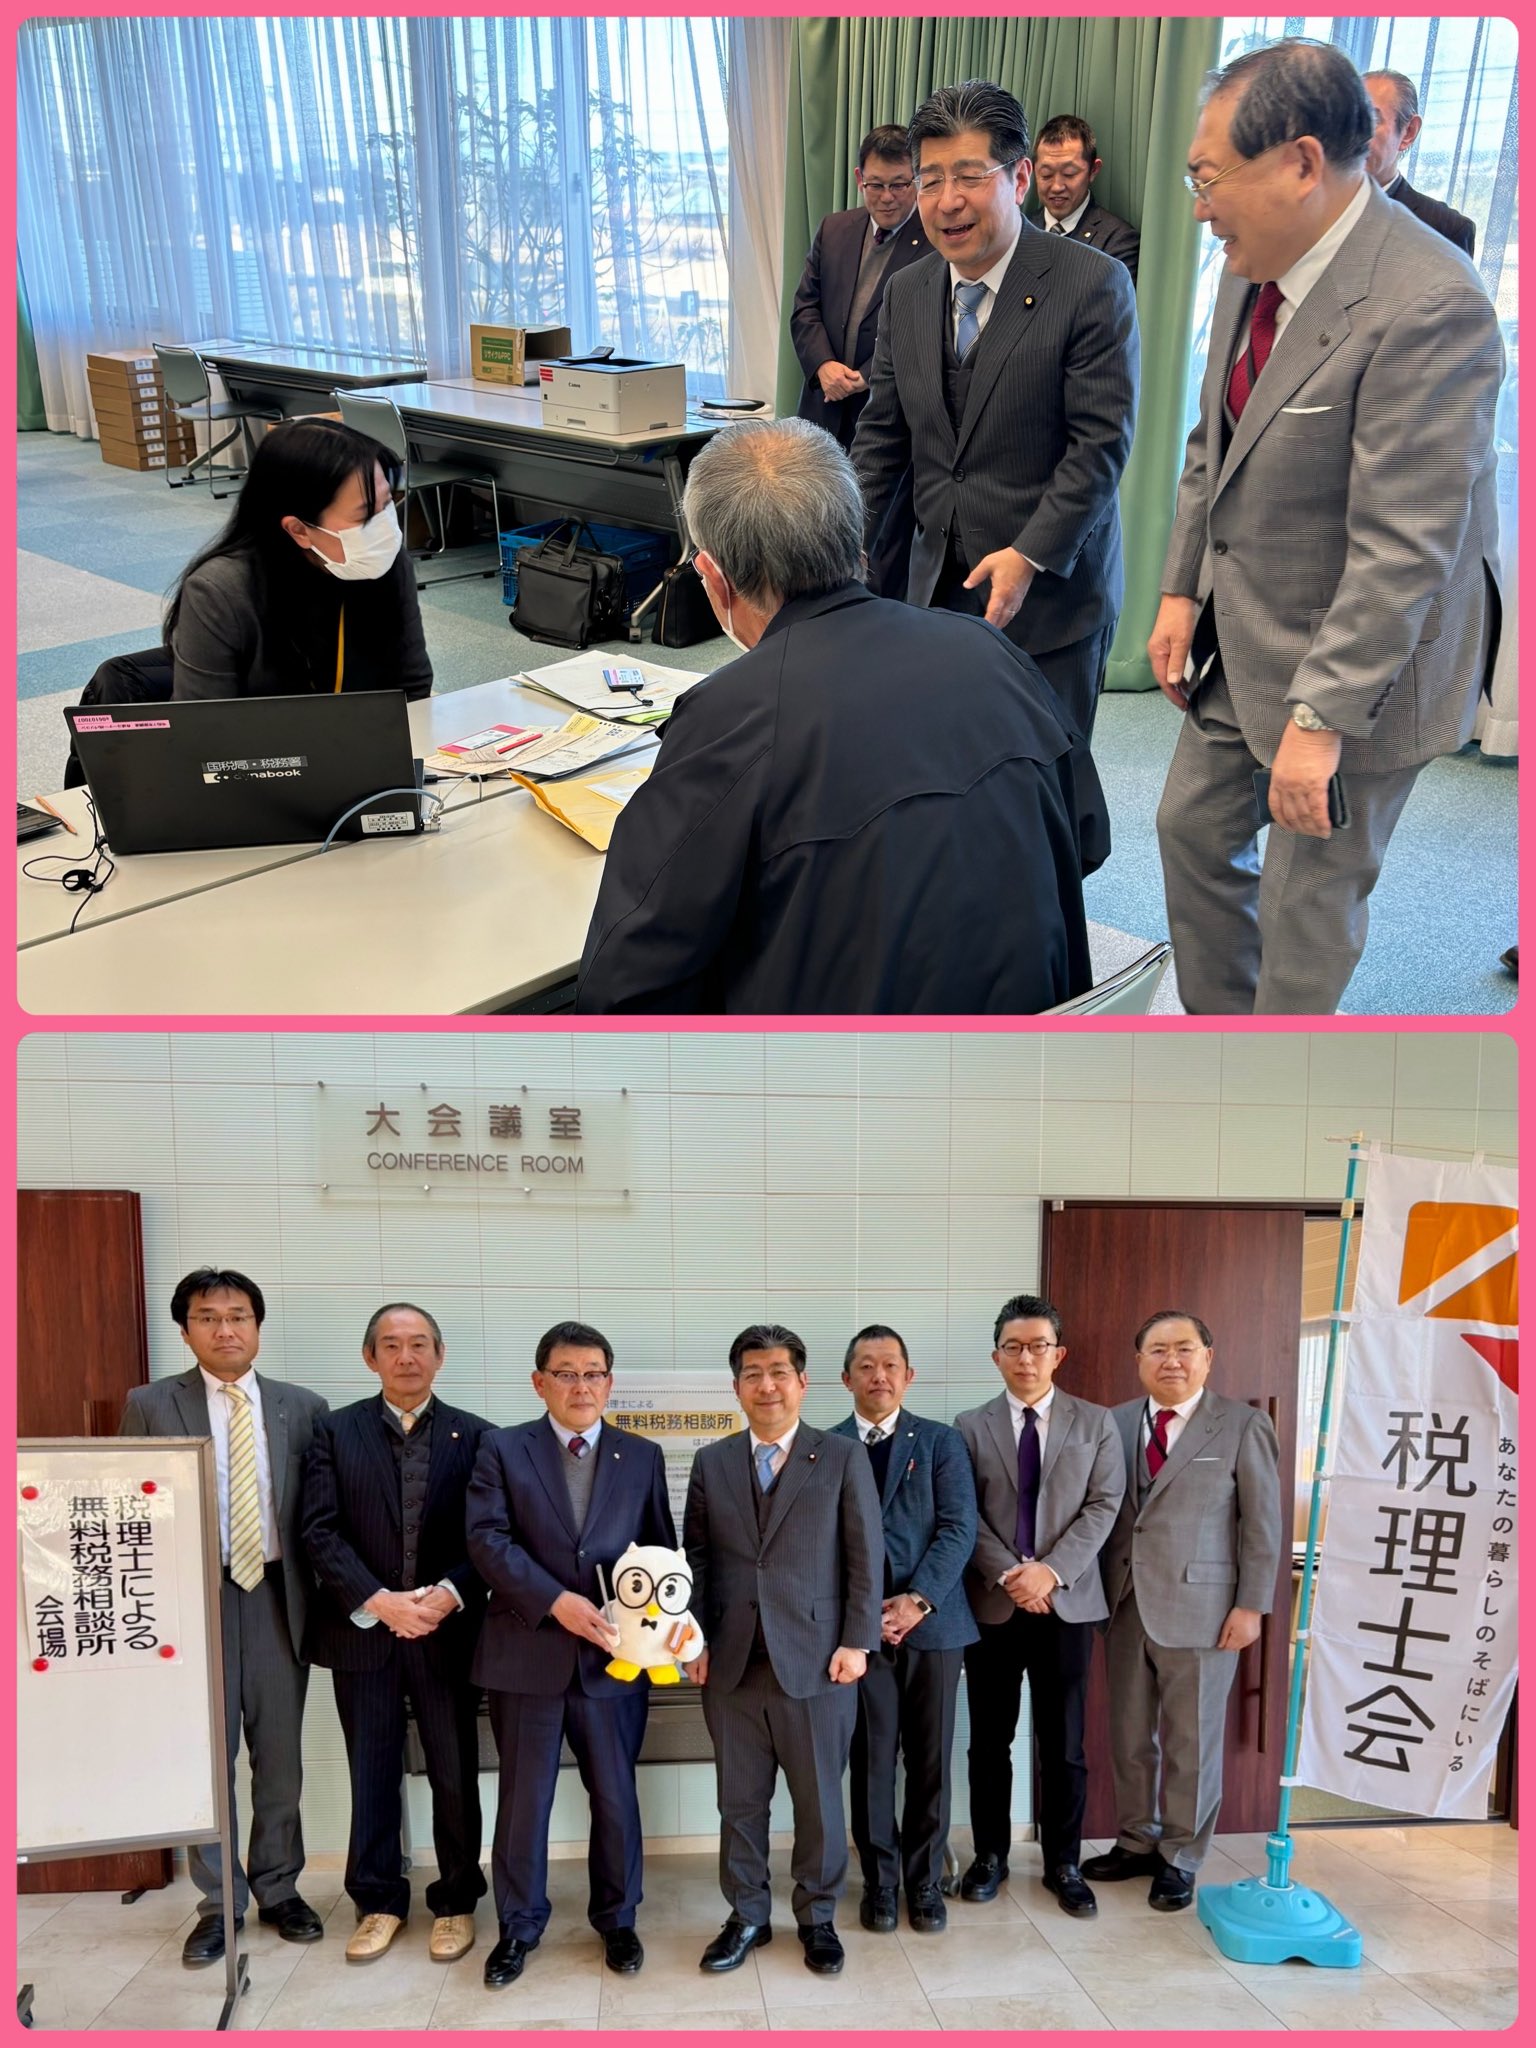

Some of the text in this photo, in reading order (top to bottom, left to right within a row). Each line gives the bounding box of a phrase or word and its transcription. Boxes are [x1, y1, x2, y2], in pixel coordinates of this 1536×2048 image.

[483, 349, 512, 361] リサイクルPPC
[206, 757, 302, 772] 国税局・税務署
[233, 769, 302, 781] dnabook
[365, 1102, 582, 1140] 大会議室
[367, 1152, 584, 1174] CONFERENCE ROOM
[615, 1413, 733, 1430] 無料税務相談所
[67, 1495, 117, 1656] 無料税務相談所
[114, 1494, 158, 1650] 税理士による
[1344, 1411, 1477, 1773] 税理士会
[1447, 1436, 1517, 1773] あなたの暮らしのそばにいる
[34, 1594, 67, 1658] 会場
